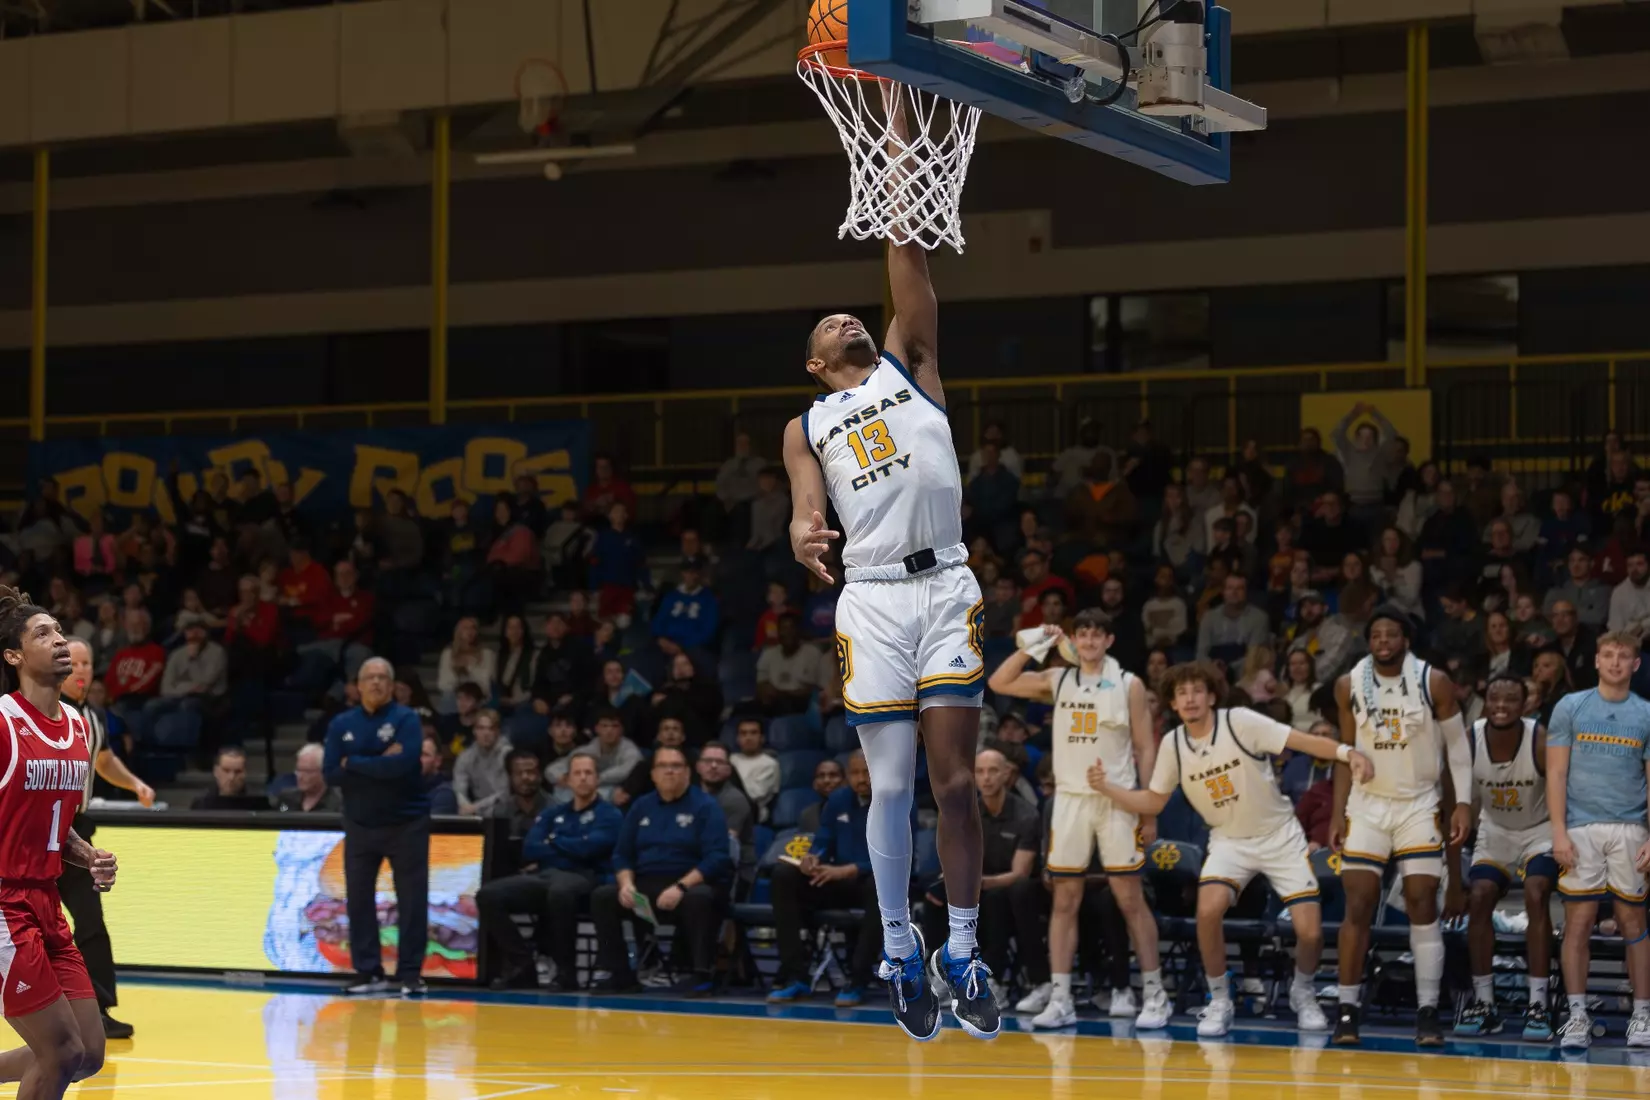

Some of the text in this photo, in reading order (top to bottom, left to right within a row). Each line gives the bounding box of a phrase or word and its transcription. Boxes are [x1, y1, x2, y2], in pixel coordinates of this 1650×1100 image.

[815, 388, 912, 453] KANSAS
[847, 419, 898, 470] 13
[349, 436, 578, 519] ROOS
[850, 453, 912, 492] CITY
[1070, 711, 1097, 734] 30
[1067, 736, 1099, 745] CITY
[1372, 742, 1409, 751] CITY
[24, 759, 59, 791] SOUTH
[1188, 757, 1242, 783] KANSAS
[1204, 773, 1236, 800] 35
[46, 800, 62, 852] 1
